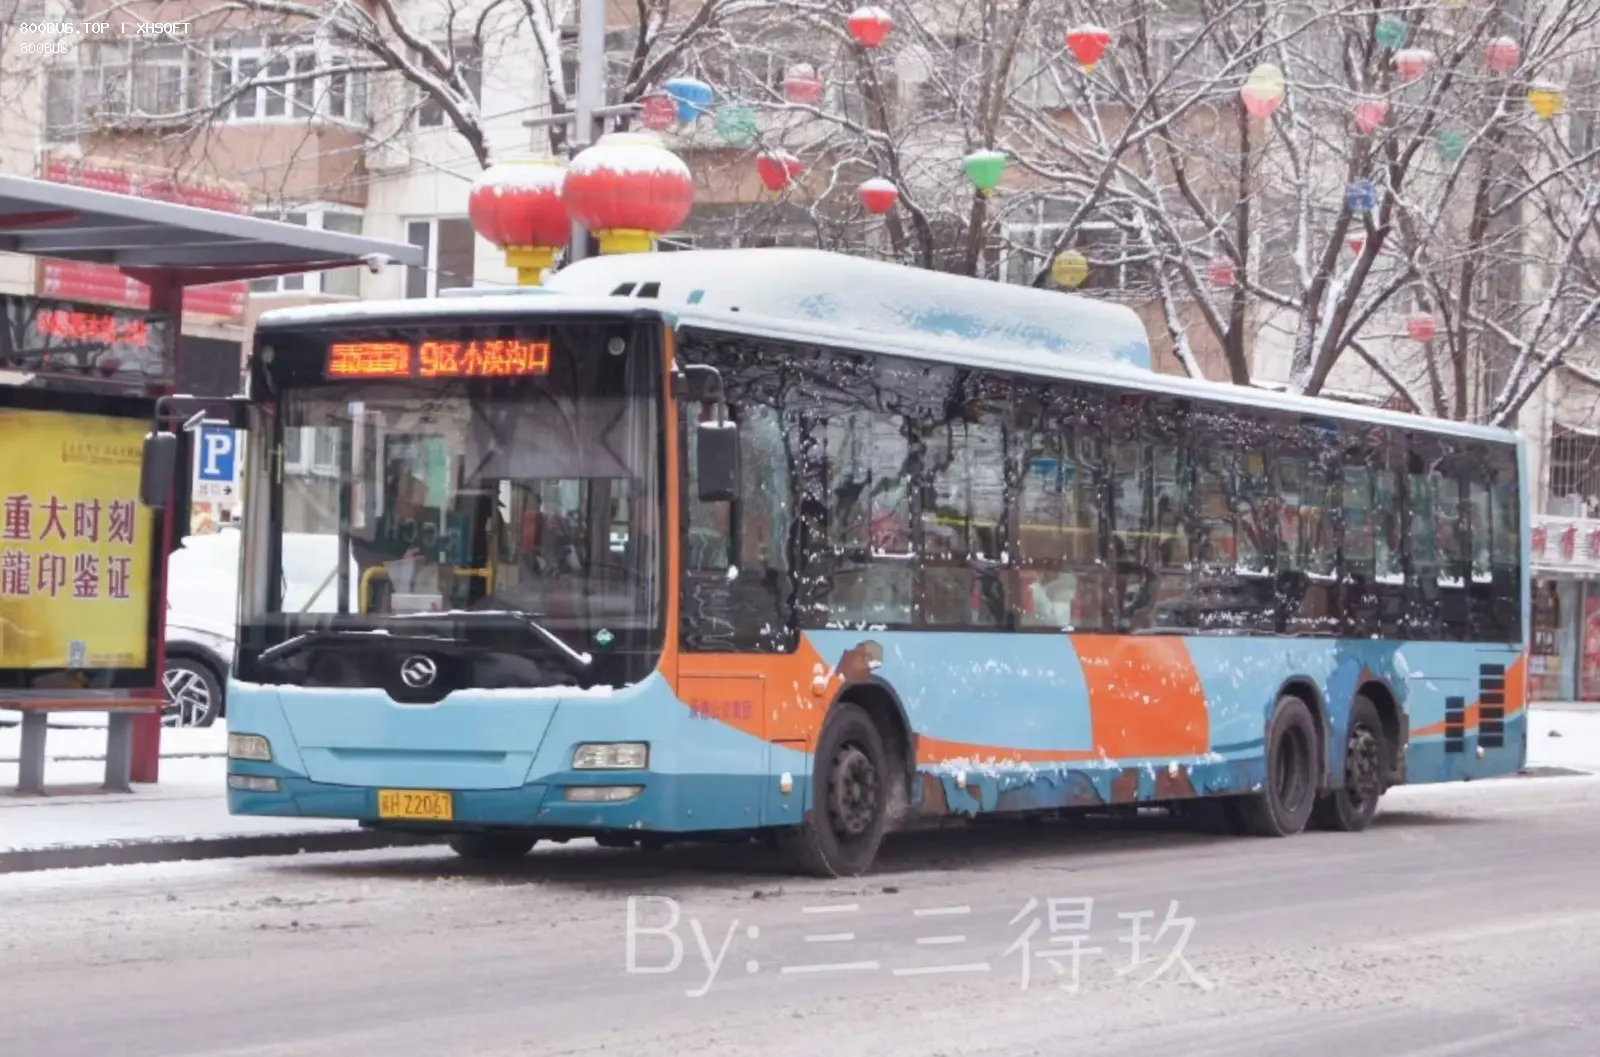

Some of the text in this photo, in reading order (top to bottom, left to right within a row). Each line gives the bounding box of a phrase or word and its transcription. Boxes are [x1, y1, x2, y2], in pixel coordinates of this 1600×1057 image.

[204, 433, 231, 474] P
[2, 494, 135, 544] 重大时刻
[1, 550, 132, 599] 龍印鉴证
